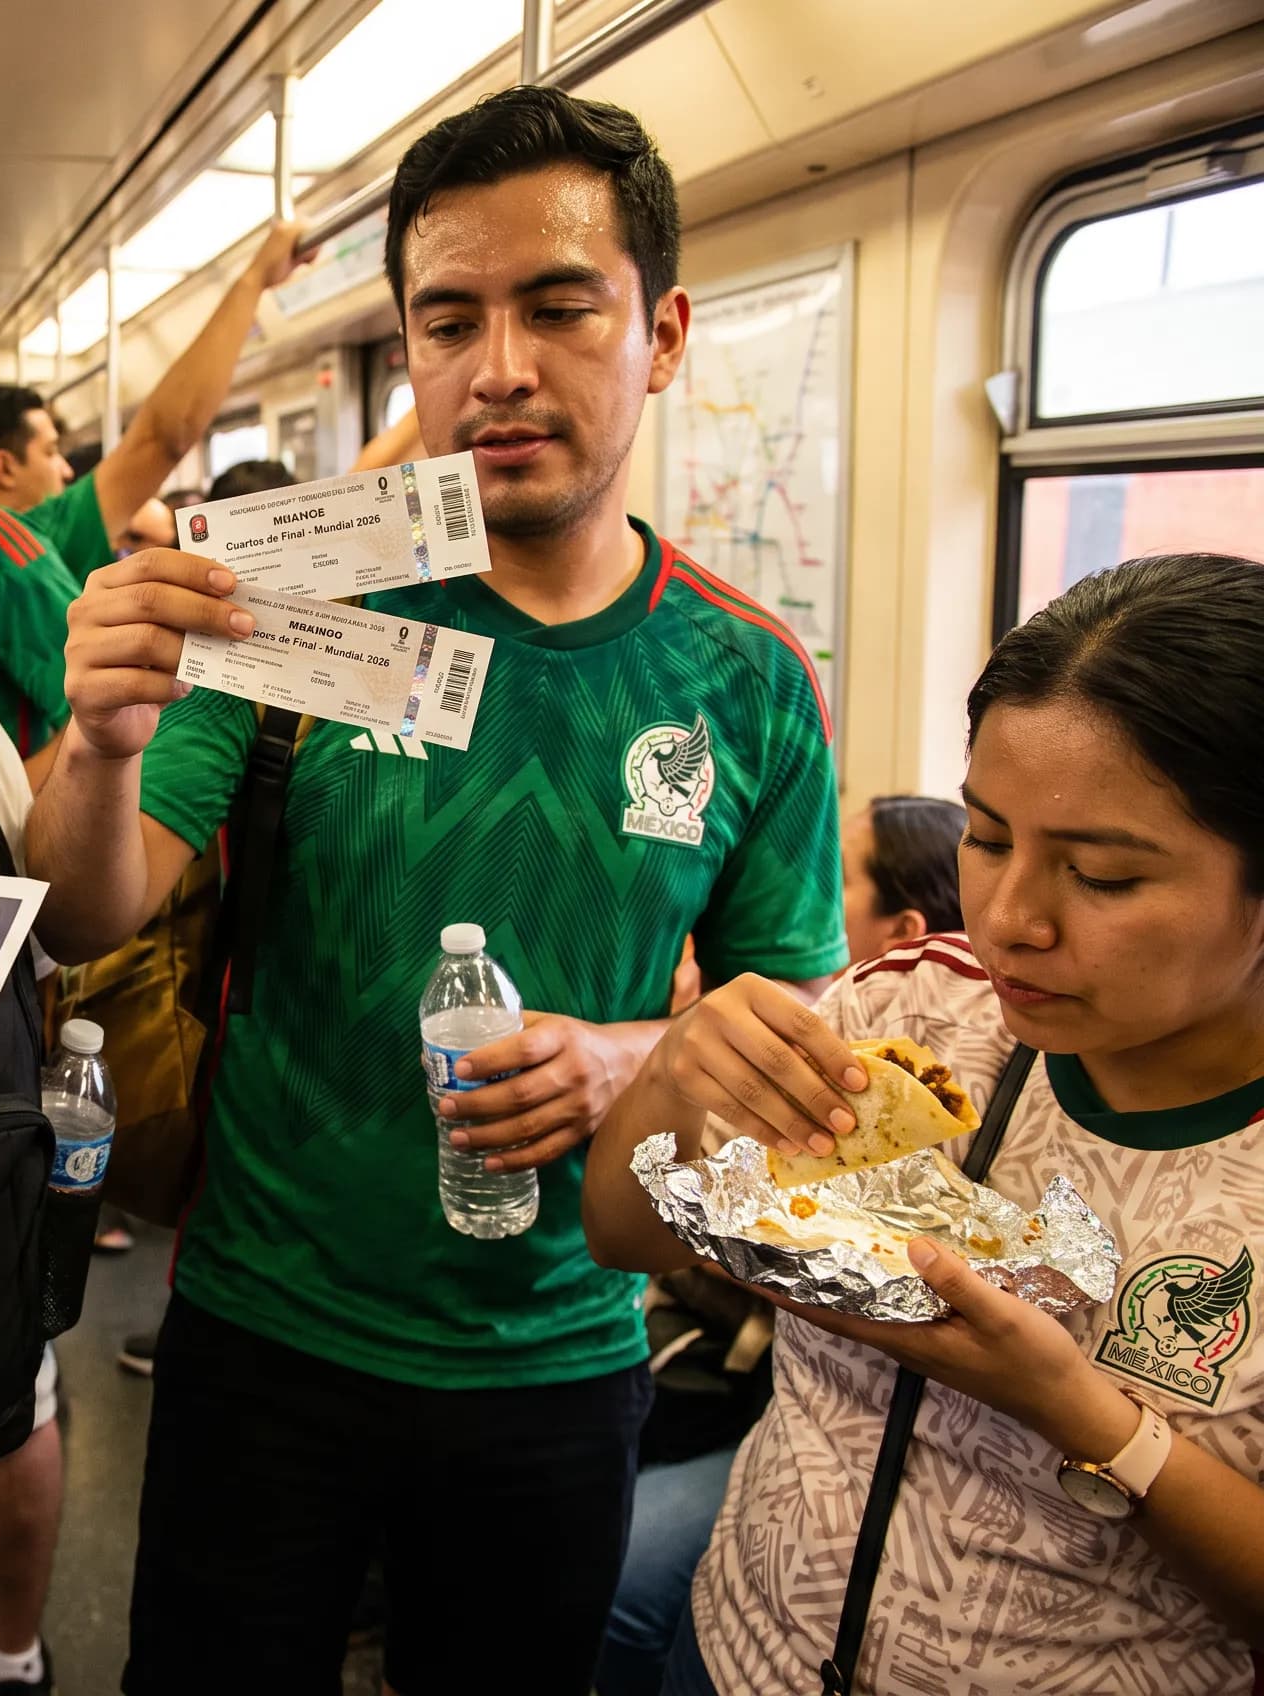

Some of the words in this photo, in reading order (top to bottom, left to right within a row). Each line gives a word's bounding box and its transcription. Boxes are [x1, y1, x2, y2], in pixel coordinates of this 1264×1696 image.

[226, 536, 264, 551] Cuartos
[267, 533, 278, 543] de
[280, 528, 305, 541] Final
[313, 519, 354, 534] Mundial
[355, 514, 381, 527] 2026
[278, 634, 290, 644] de
[292, 637, 316, 650] Final
[366, 654, 390, 667] 2026
[1108, 1342, 1211, 1394] MÉXICO
